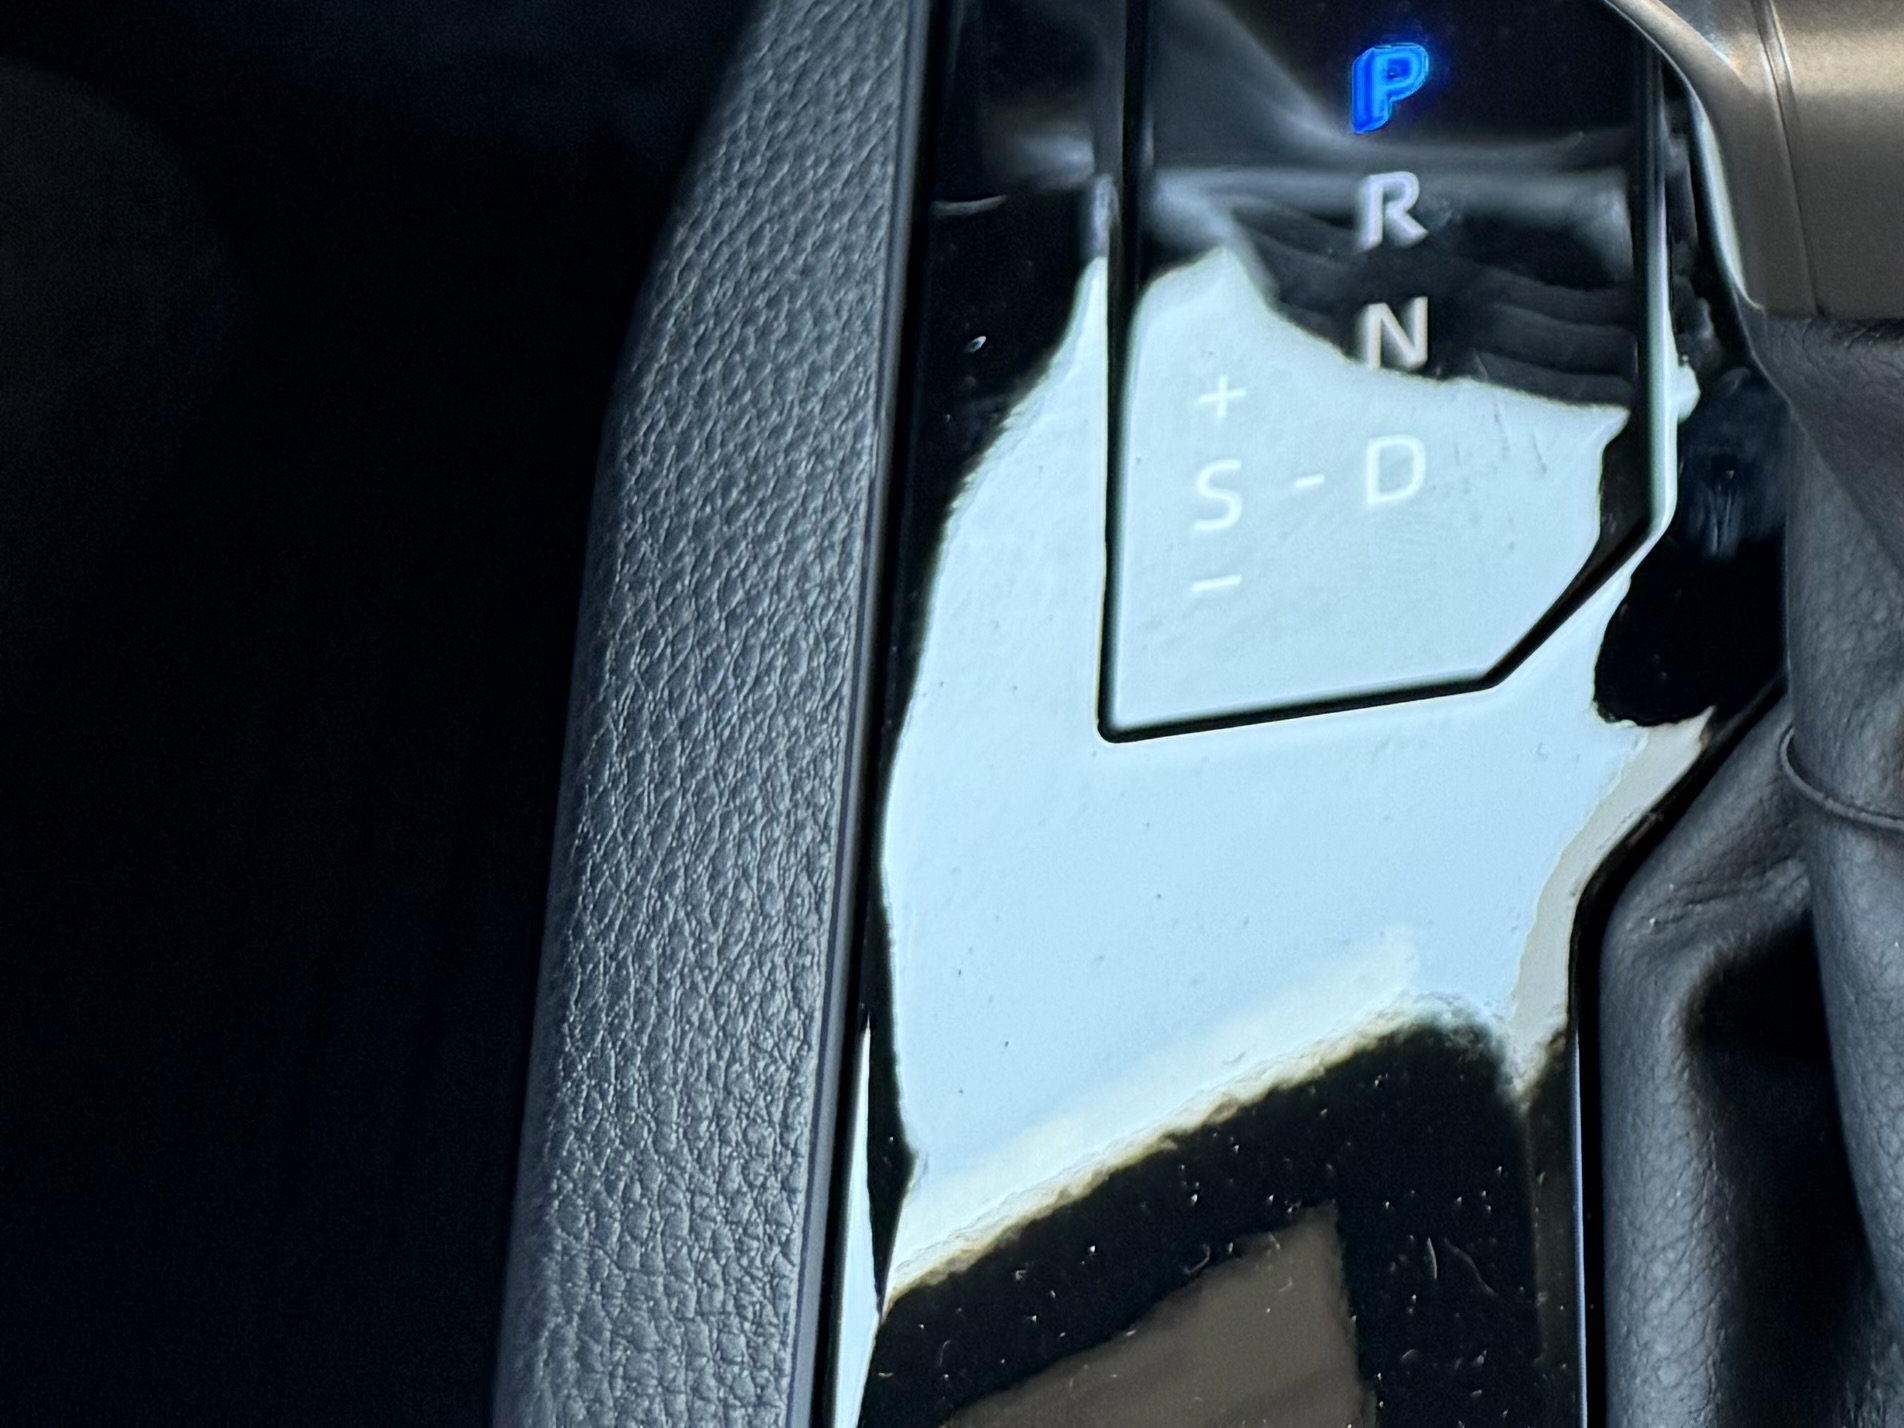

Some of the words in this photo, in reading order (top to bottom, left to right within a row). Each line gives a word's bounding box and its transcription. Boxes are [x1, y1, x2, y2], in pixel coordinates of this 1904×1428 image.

[1350, 42, 1431, 135] P
[1357, 170, 1428, 253] R
[1363, 295, 1429, 372] N
[1193, 459, 1244, 530] S
[1364, 434, 1427, 506] D
